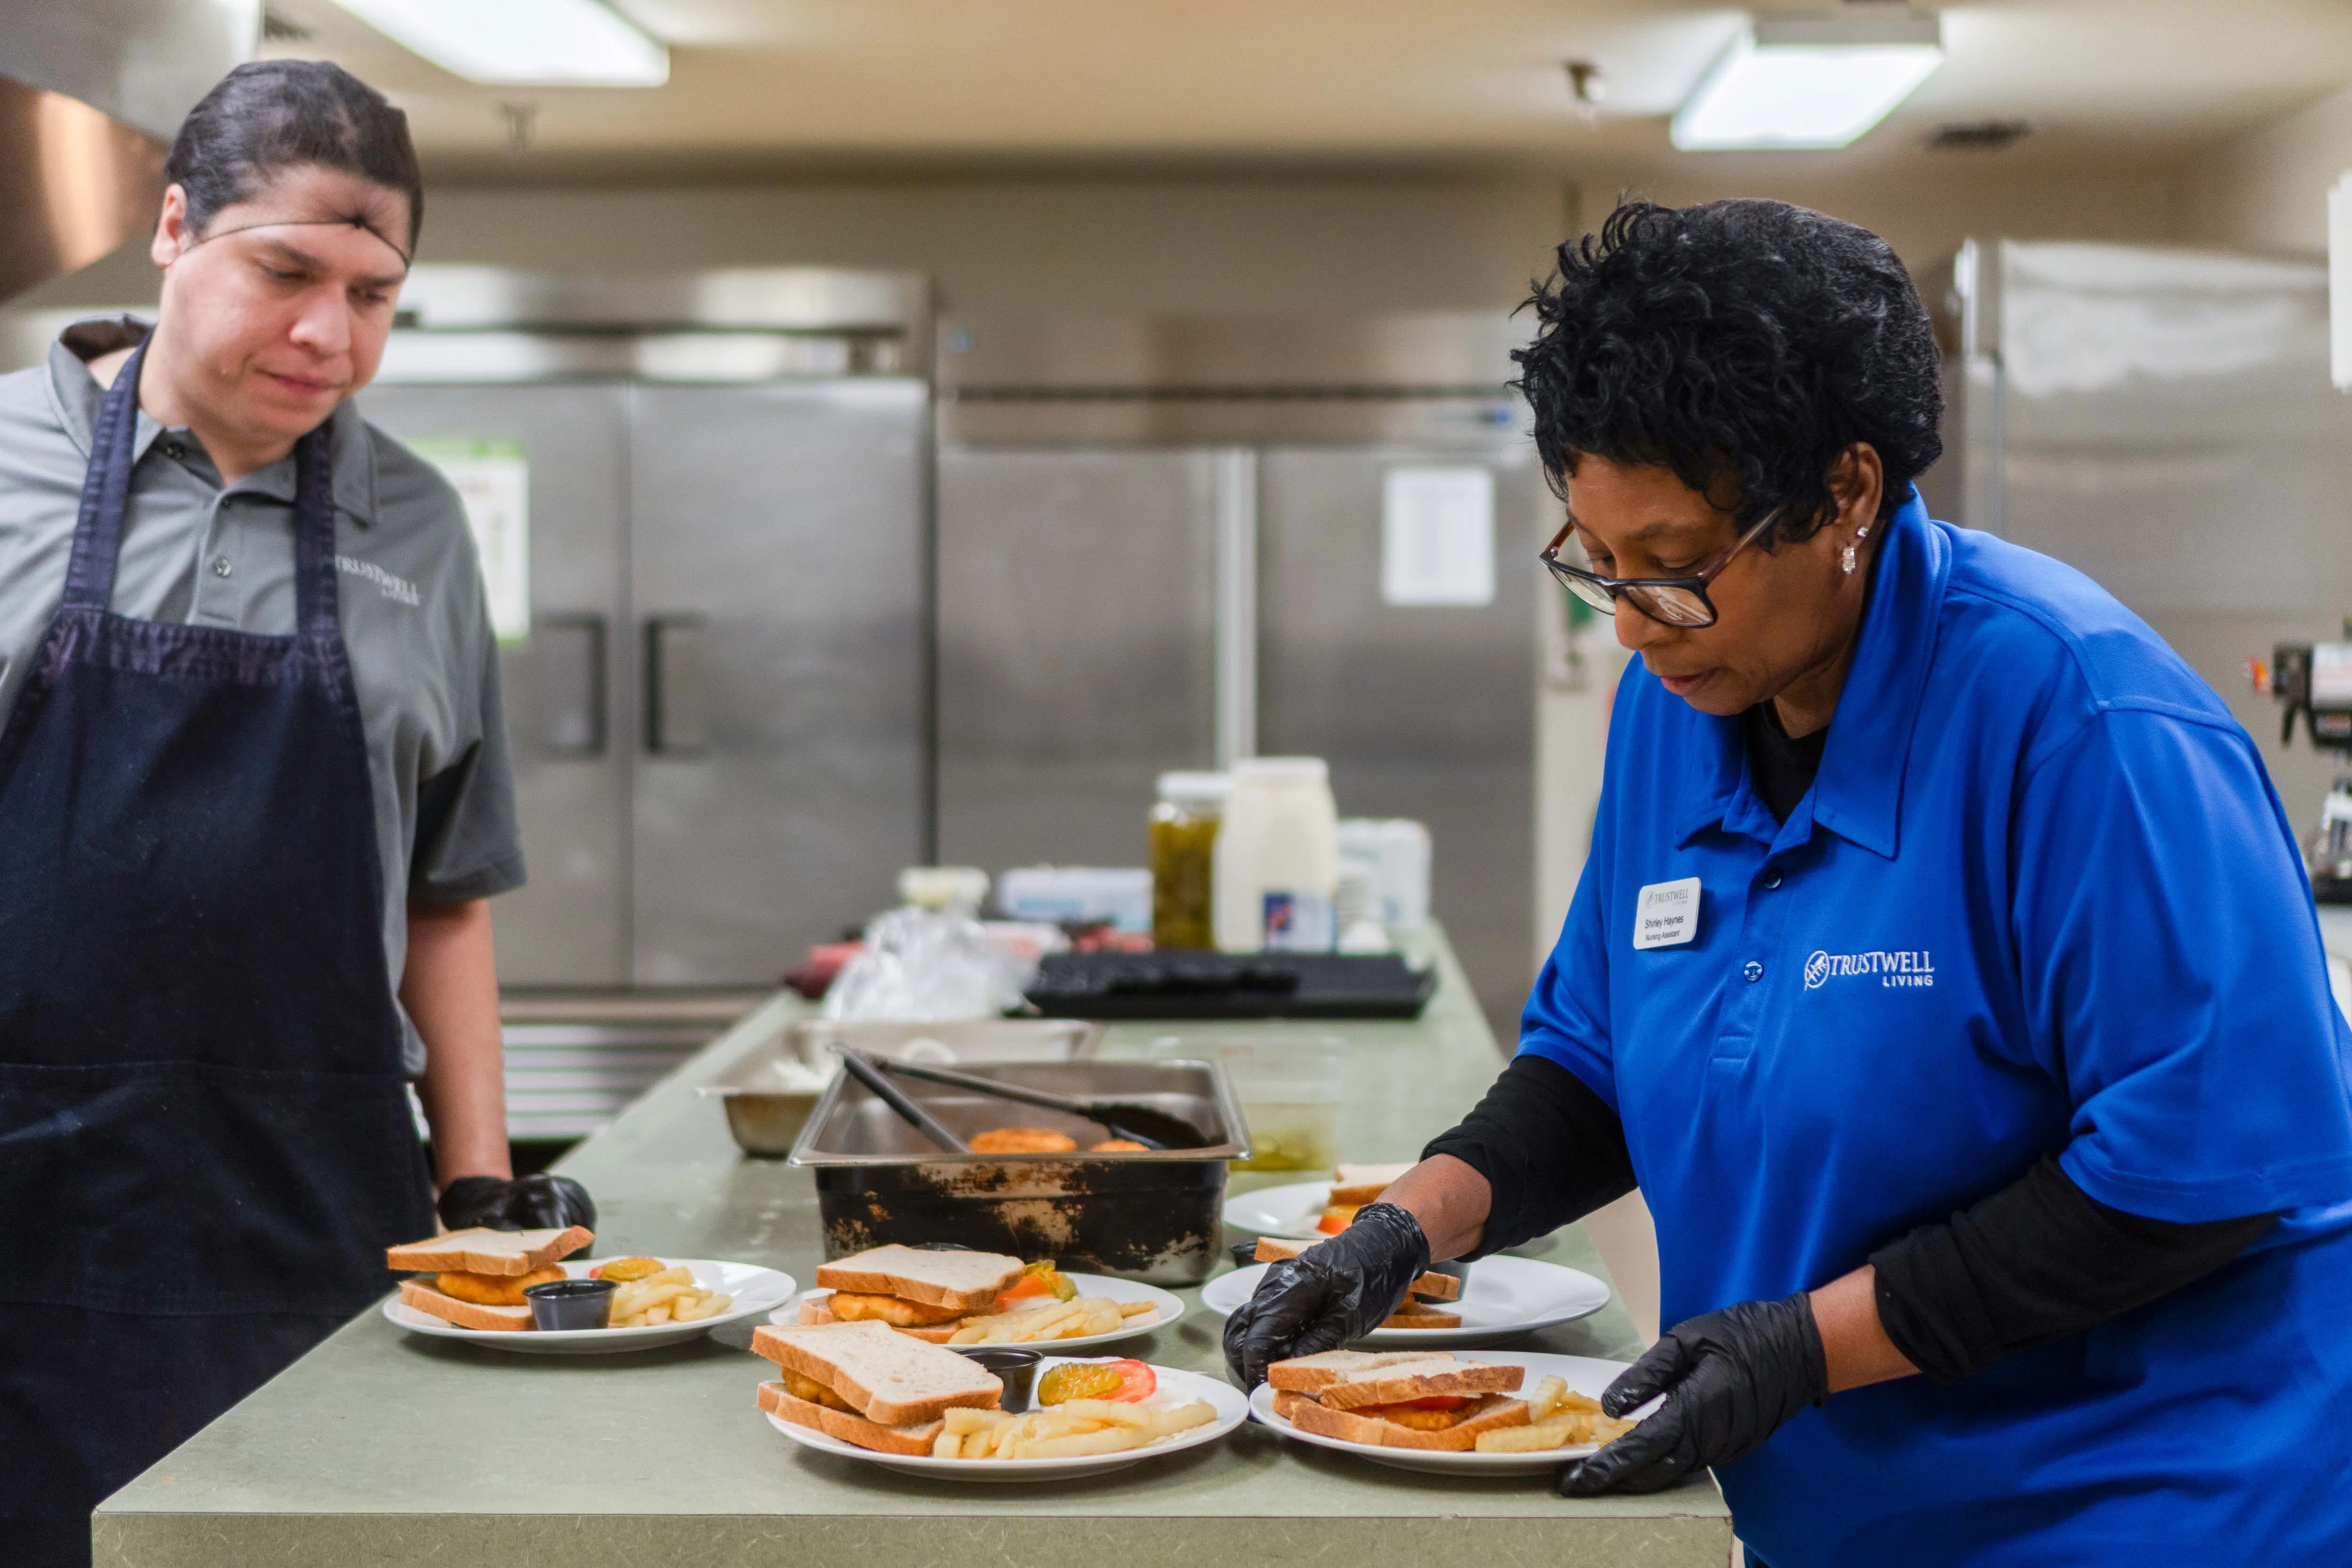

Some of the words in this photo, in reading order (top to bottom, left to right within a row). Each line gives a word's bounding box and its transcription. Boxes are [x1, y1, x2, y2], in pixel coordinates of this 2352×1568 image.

[1655, 888, 1689, 904] TRUSTWELL
[1645, 919, 1662, 929] Shirley
[1664, 916, 1684, 927] Haynes
[1662, 930, 1680, 939] Assistant
[1829, 951, 1935, 976] TRUSTWELL
[1882, 975, 1933, 987] LIVING
